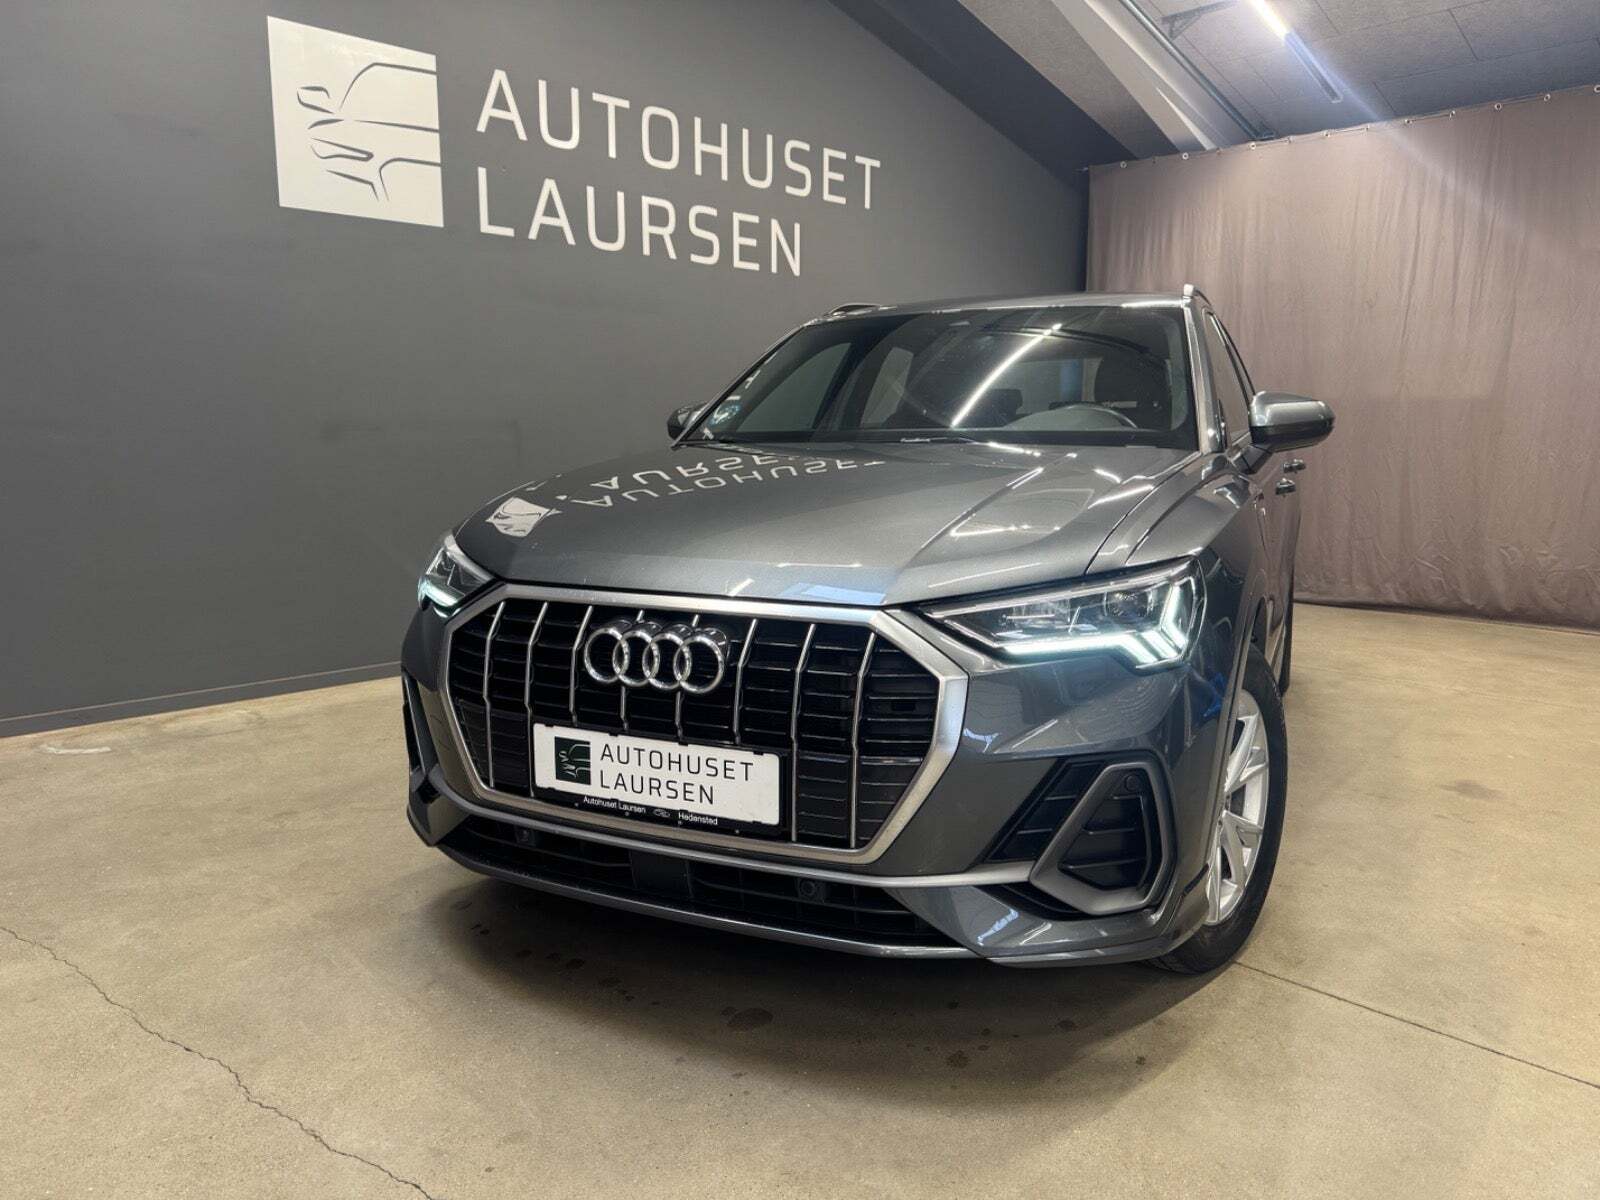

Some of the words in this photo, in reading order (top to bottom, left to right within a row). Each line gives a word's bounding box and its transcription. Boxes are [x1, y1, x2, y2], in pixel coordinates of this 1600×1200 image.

[475, 68, 881, 210] AUTOHUSET
[477, 166, 801, 278] LAURSEN
[600, 743, 754, 782] AUTOHUSET
[600, 769, 714, 805] LAURSEN
[583, 795, 617, 809] Autohuset
[619, 800, 647, 814] Laursen
[678, 811, 719, 826] Hedensted
